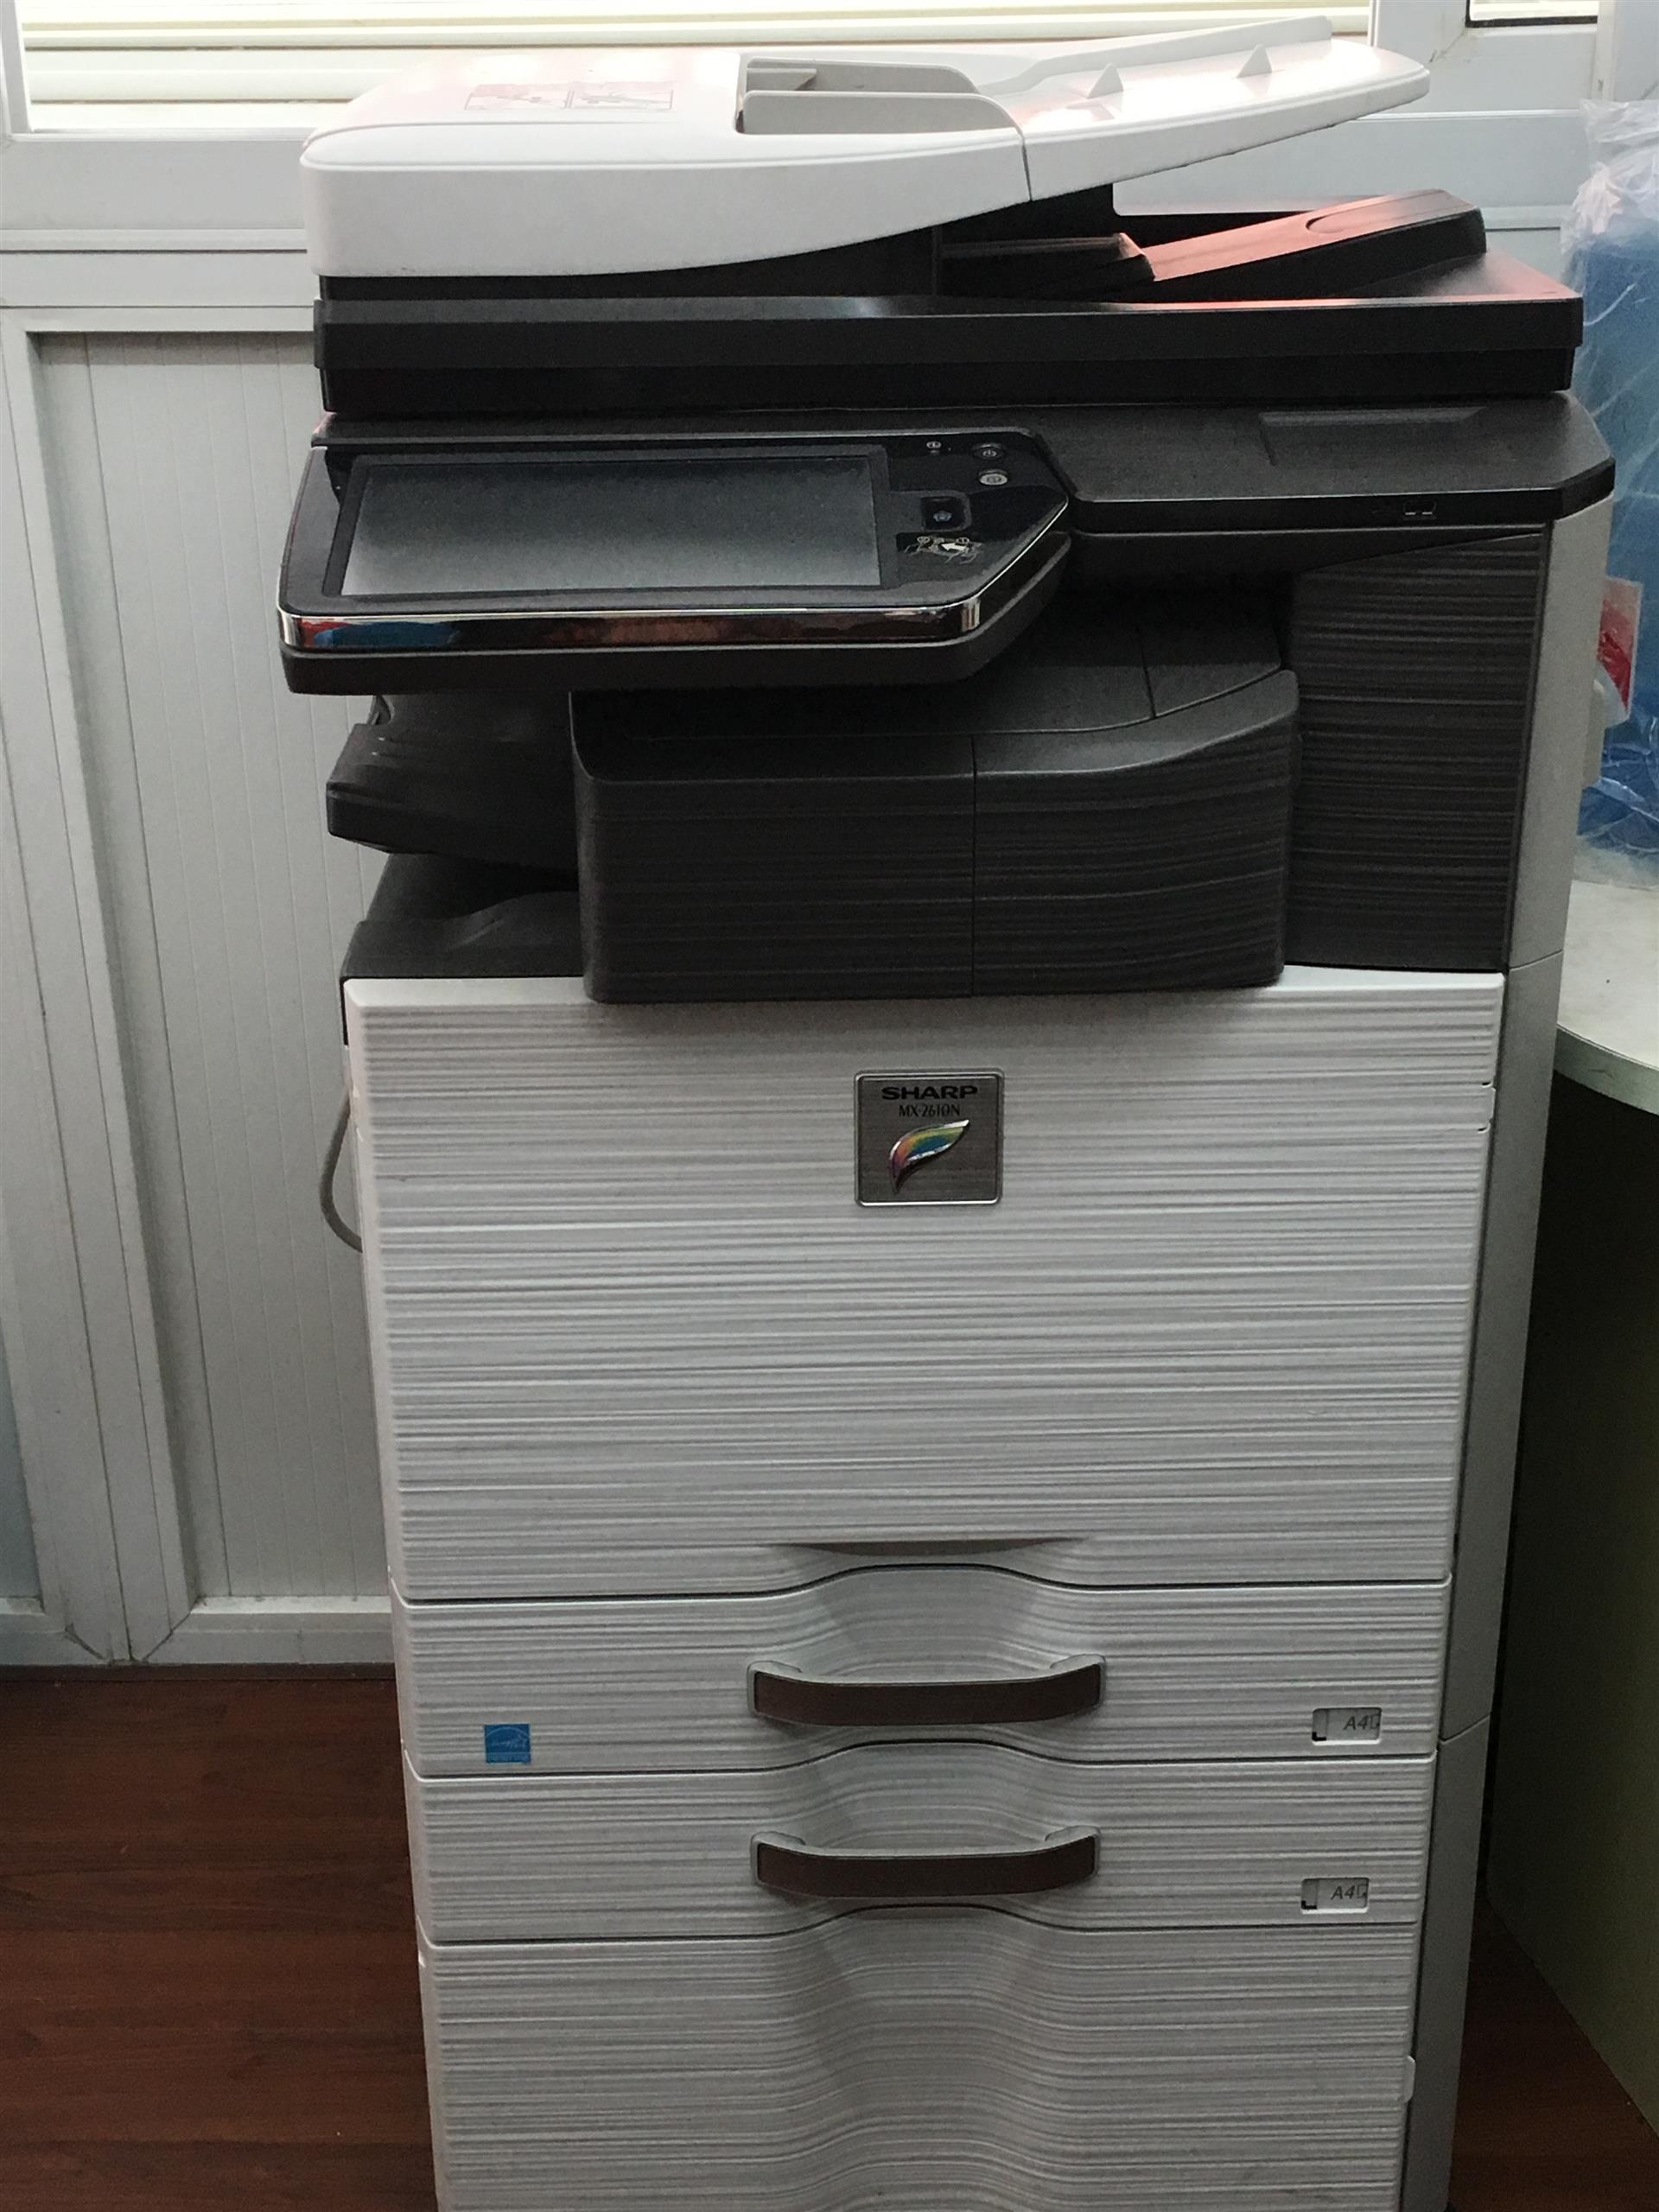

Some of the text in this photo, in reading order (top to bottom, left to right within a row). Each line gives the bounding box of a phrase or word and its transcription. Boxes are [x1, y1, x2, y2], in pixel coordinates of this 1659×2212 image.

[881, 1085, 977, 1100] SHARP
[899, 1104, 960, 1117] MX-2610N
[1344, 1715, 1369, 1731] A4
[1331, 1885, 1355, 1900] A4
